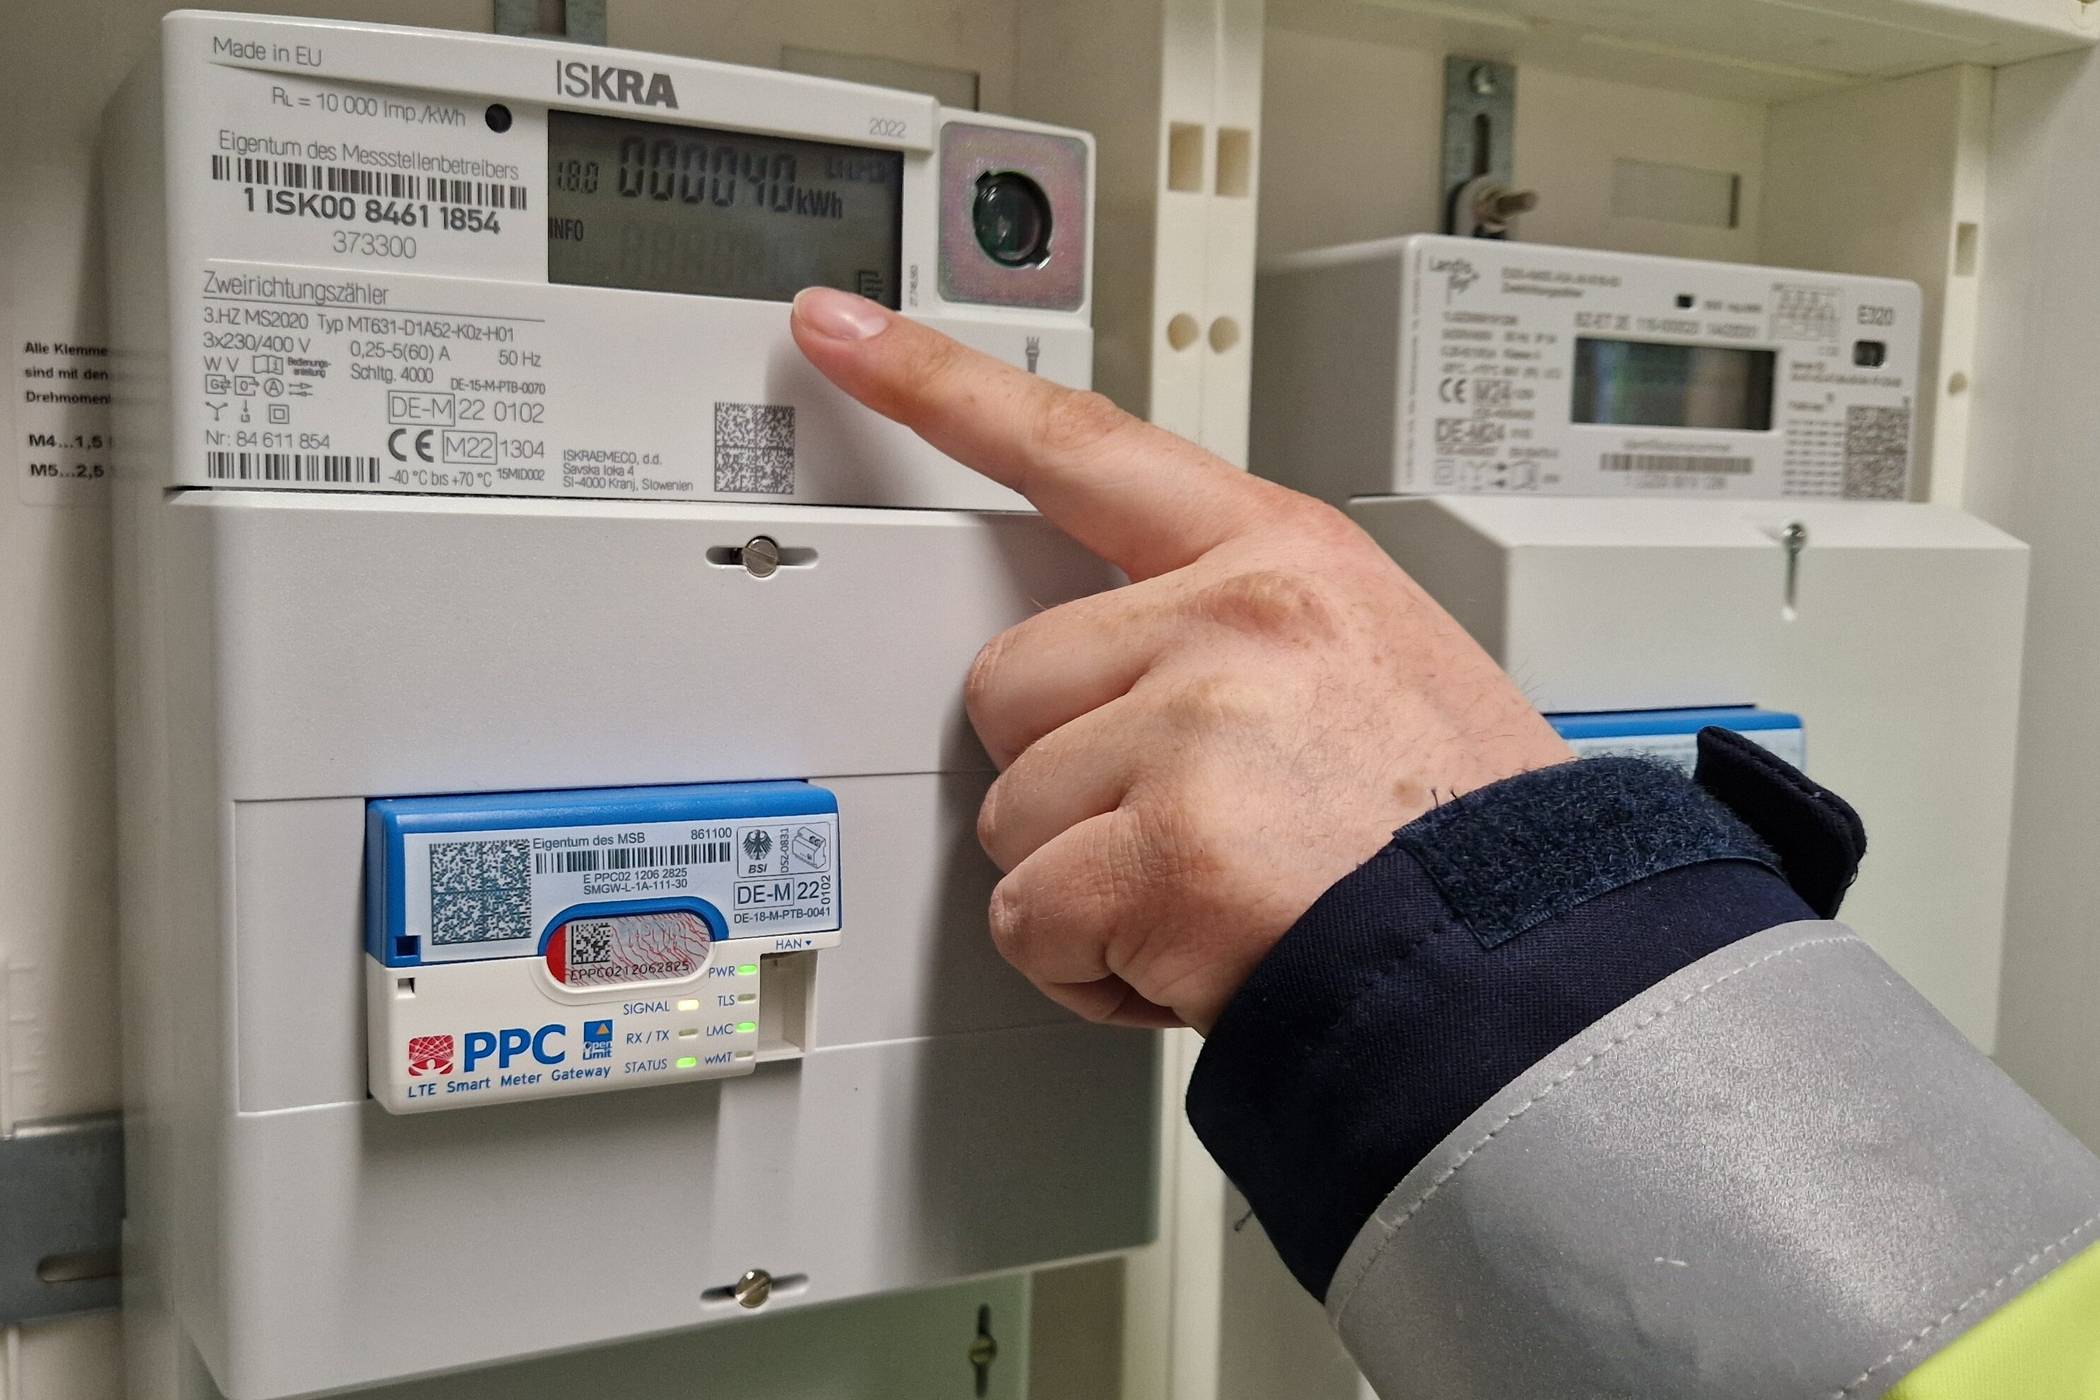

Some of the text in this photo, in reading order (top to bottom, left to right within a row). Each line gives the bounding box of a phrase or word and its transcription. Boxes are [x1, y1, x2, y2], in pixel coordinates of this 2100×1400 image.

[213, 36, 323, 67] Made in EU
[557, 60, 679, 109] ISKRA
[383, 98, 466, 128] Imp./kWh
[869, 118, 906, 139] 2022
[219, 129, 519, 181] Eigentum des Messstellenbetreibers
[618, 136, 844, 221] 000040 kWh
[244, 187, 500, 235] 1 ISK00 8461 1854
[549, 216, 585, 242] INFO
[332, 230, 417, 259] 373300
[203, 270, 389, 305] Zweirichtungszähler
[203, 306, 241, 326] 3.HZ
[245, 309, 309, 330] MS2020
[317, 314, 344, 336] Typ
[25, 342, 49, 355] Alle
[203, 332, 311, 354] 3x230/400 V
[350, 341, 451, 363] 0,25-5(60) A
[499, 351, 542, 368] 50 Hz
[25, 366, 109, 381] sind mit den
[401, 367, 434, 384] 4000
[451, 378, 546, 395] DE-15-M-PTB-0070
[391, 396, 545, 424] DE-M 22 0102
[237, 433, 257, 448] 84
[263, 432, 293, 449] 611
[300, 433, 330, 450] 854
[446, 436, 545, 460] M22 1304
[563, 449, 640, 465] ISKRAEMECO,
[389, 469, 409, 484] -40
[431, 469, 449, 486] bis
[452, 472, 475, 487] +70
[563, 463, 634, 477] Savska loka 4
[609, 477, 639, 491] Kranj,
[642, 479, 694, 492] Slowenien
[533, 831, 646, 851] Eigentum des MSB
[691, 827, 732, 840] 861100
[583, 868, 688, 884] E PPC02 1206 2825
[748, 863, 768, 874] BSI
[583, 879, 688, 895] SMGW-L-1A-111-30
[737, 881, 820, 904] DE-M 22
[821, 875, 831, 904] 0102
[734, 907, 831, 924] DE-18-M-PTB-0041
[776, 938, 802, 950] HAN
[708, 964, 736, 979] PWR
[623, 1000, 670, 1015] SIGNAL
[717, 994, 736, 1007] TLS
[625, 1031, 643, 1045] RX
[655, 1029, 670, 1042] TX
[706, 1023, 734, 1037] LMC
[464, 1024, 567, 1073] PPC
[582, 1047, 613, 1061] Limit
[624, 1057, 668, 1073] STATUS
[408, 1064, 611, 1098] LTE Smart Meter Gateway
